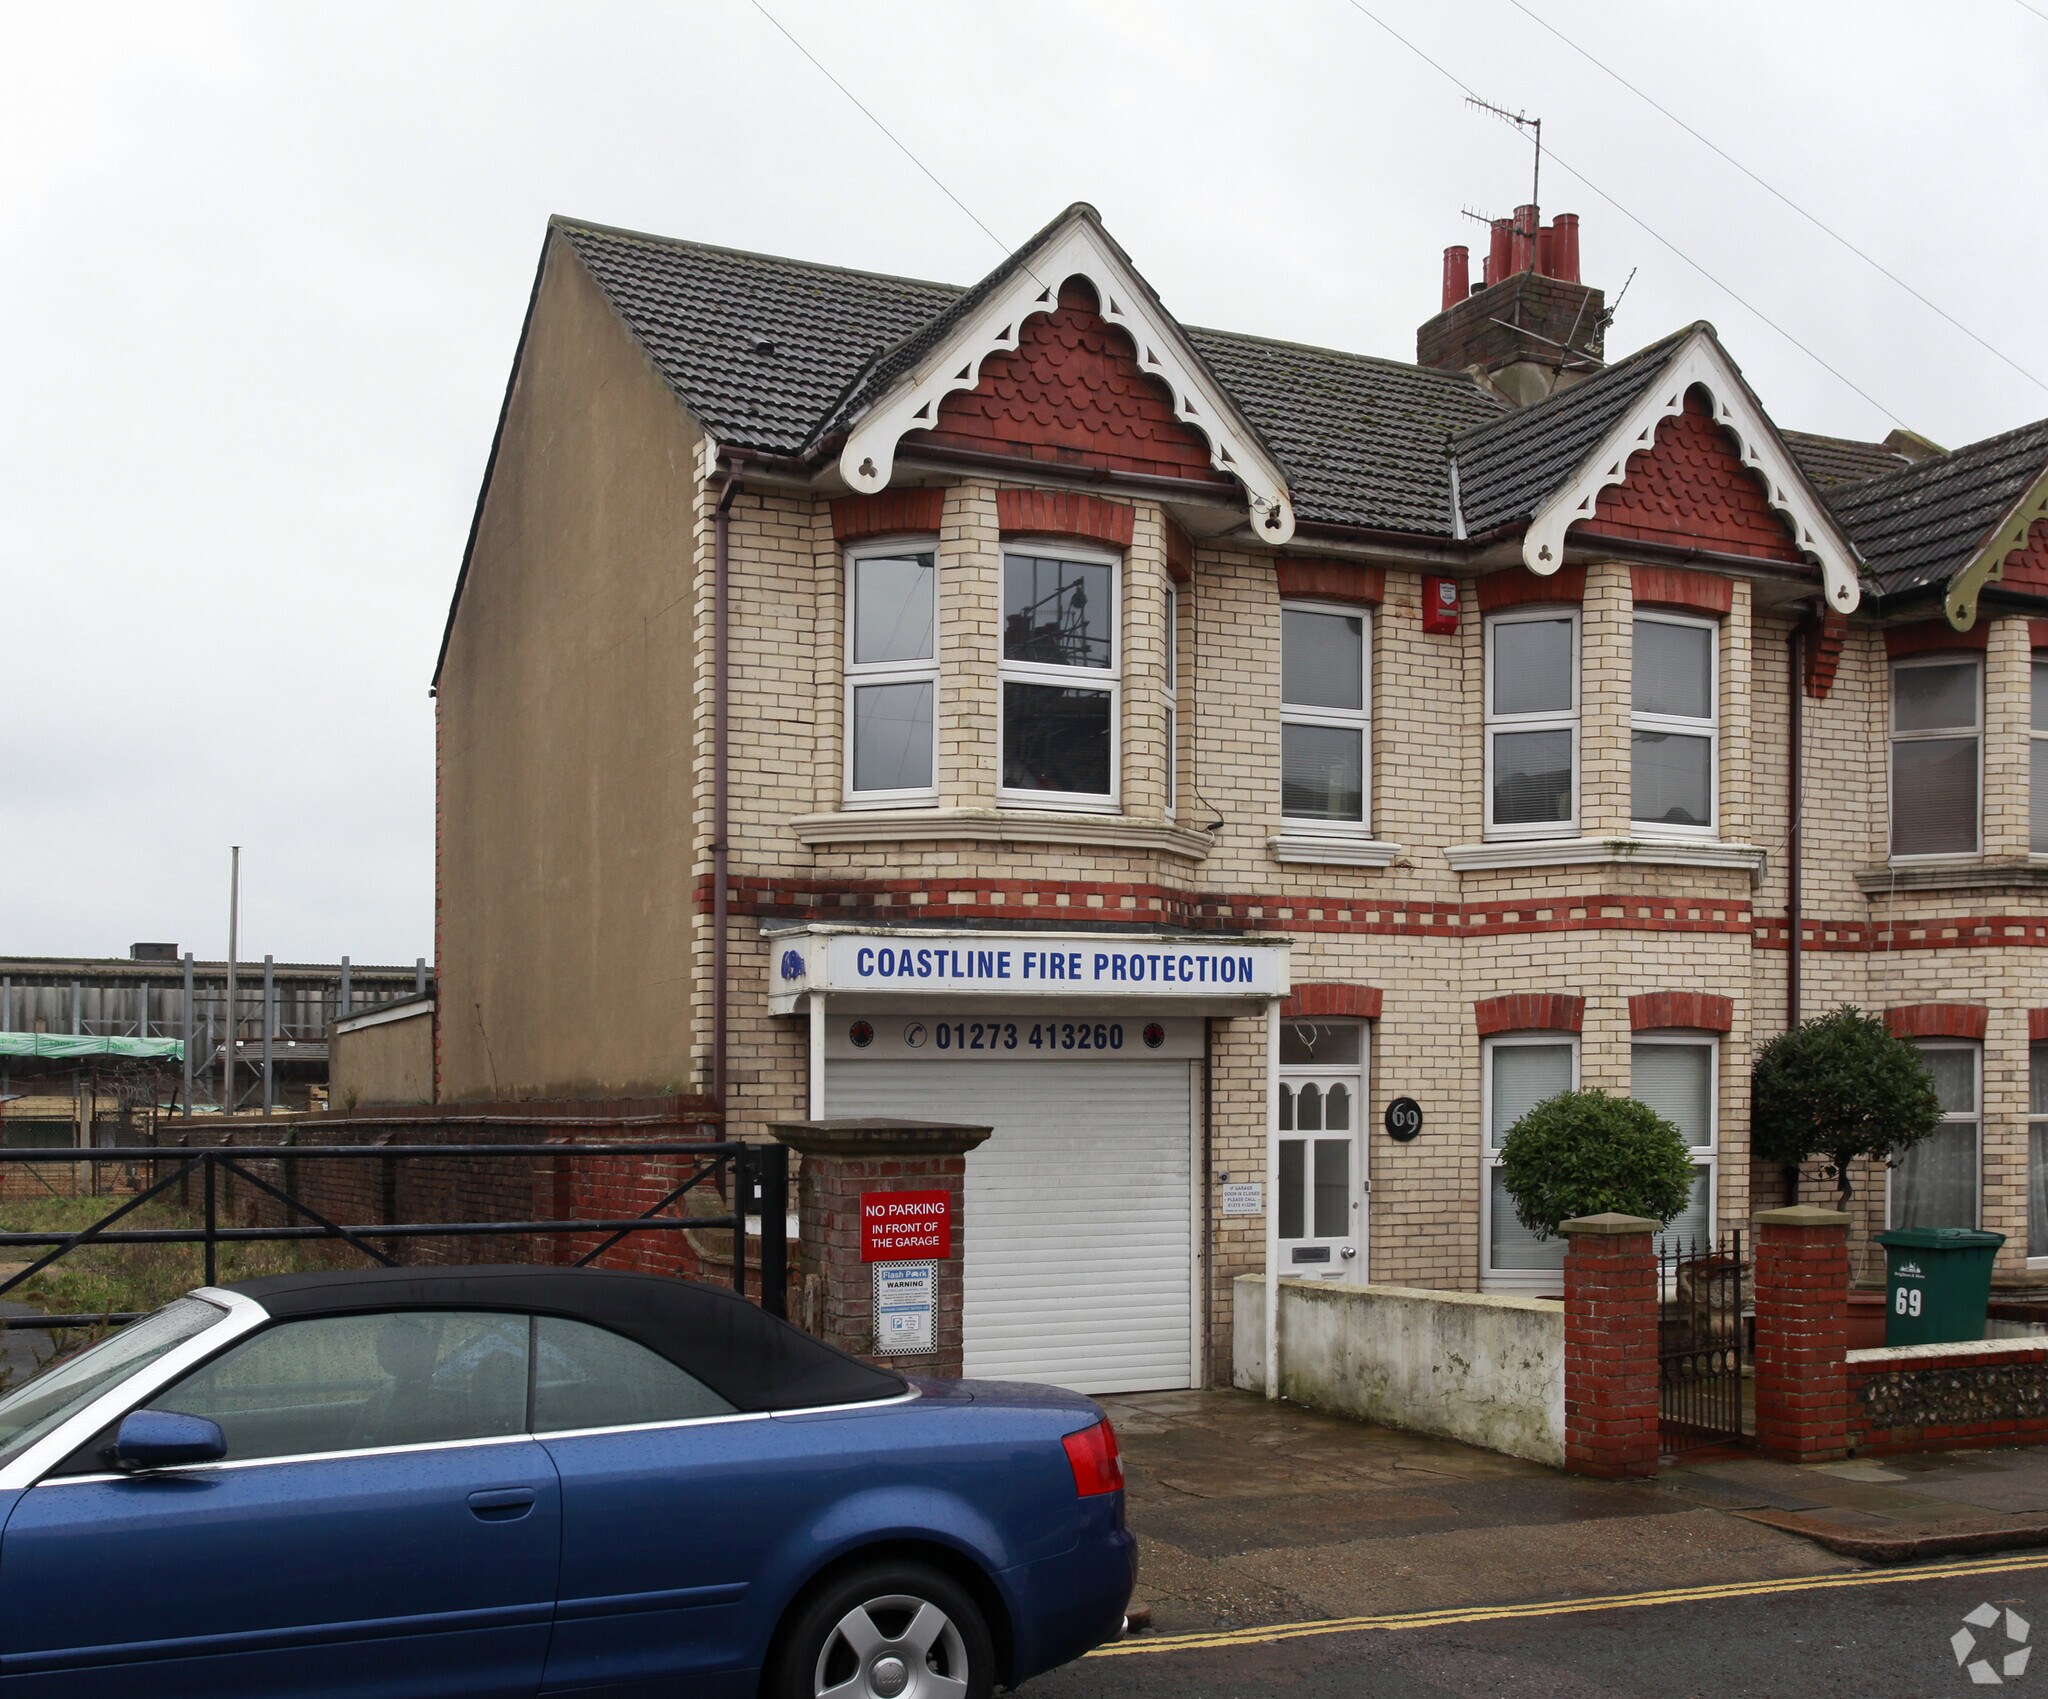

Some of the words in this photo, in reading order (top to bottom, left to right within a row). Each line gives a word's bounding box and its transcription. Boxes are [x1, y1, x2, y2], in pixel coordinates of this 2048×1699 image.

[857, 948, 1011, 979] COASTLINE
[1023, 952, 1082, 980] FIRE
[1094, 953, 1253, 983] PROTECTION
[936, 1022, 1018, 1050] 01273
[1028, 1023, 1124, 1050] 413260
[1392, 1102, 1419, 1134] 69
[865, 1205, 886, 1217] NO
[888, 1202, 945, 1216] PARKING
[872, 1224, 883, 1234] IN
[885, 1222, 921, 1234] FRONT
[924, 1221, 939, 1232] OF
[871, 1238, 893, 1248] THE
[895, 1235, 940, 1248] GARAGE
[883, 1271, 904, 1279] Flash
[887, 1280, 924, 1288] WARNING
[1895, 1287, 1922, 1317] 69
